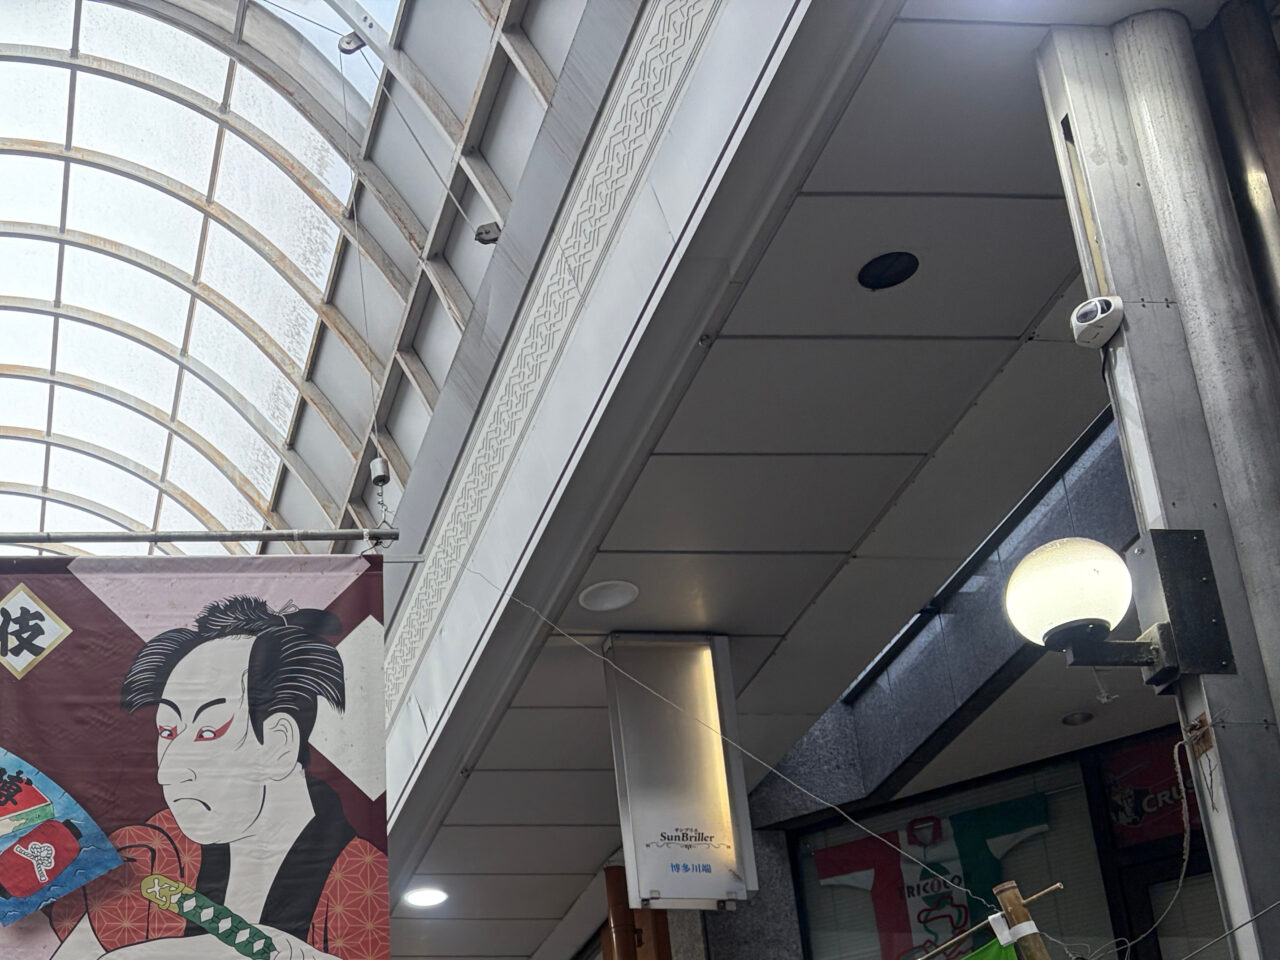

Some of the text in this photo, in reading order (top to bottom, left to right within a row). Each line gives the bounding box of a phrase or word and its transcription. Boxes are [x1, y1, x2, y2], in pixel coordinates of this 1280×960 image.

[660, 832, 715, 842] SunBriller
[671, 863, 712, 873] 博多川端
